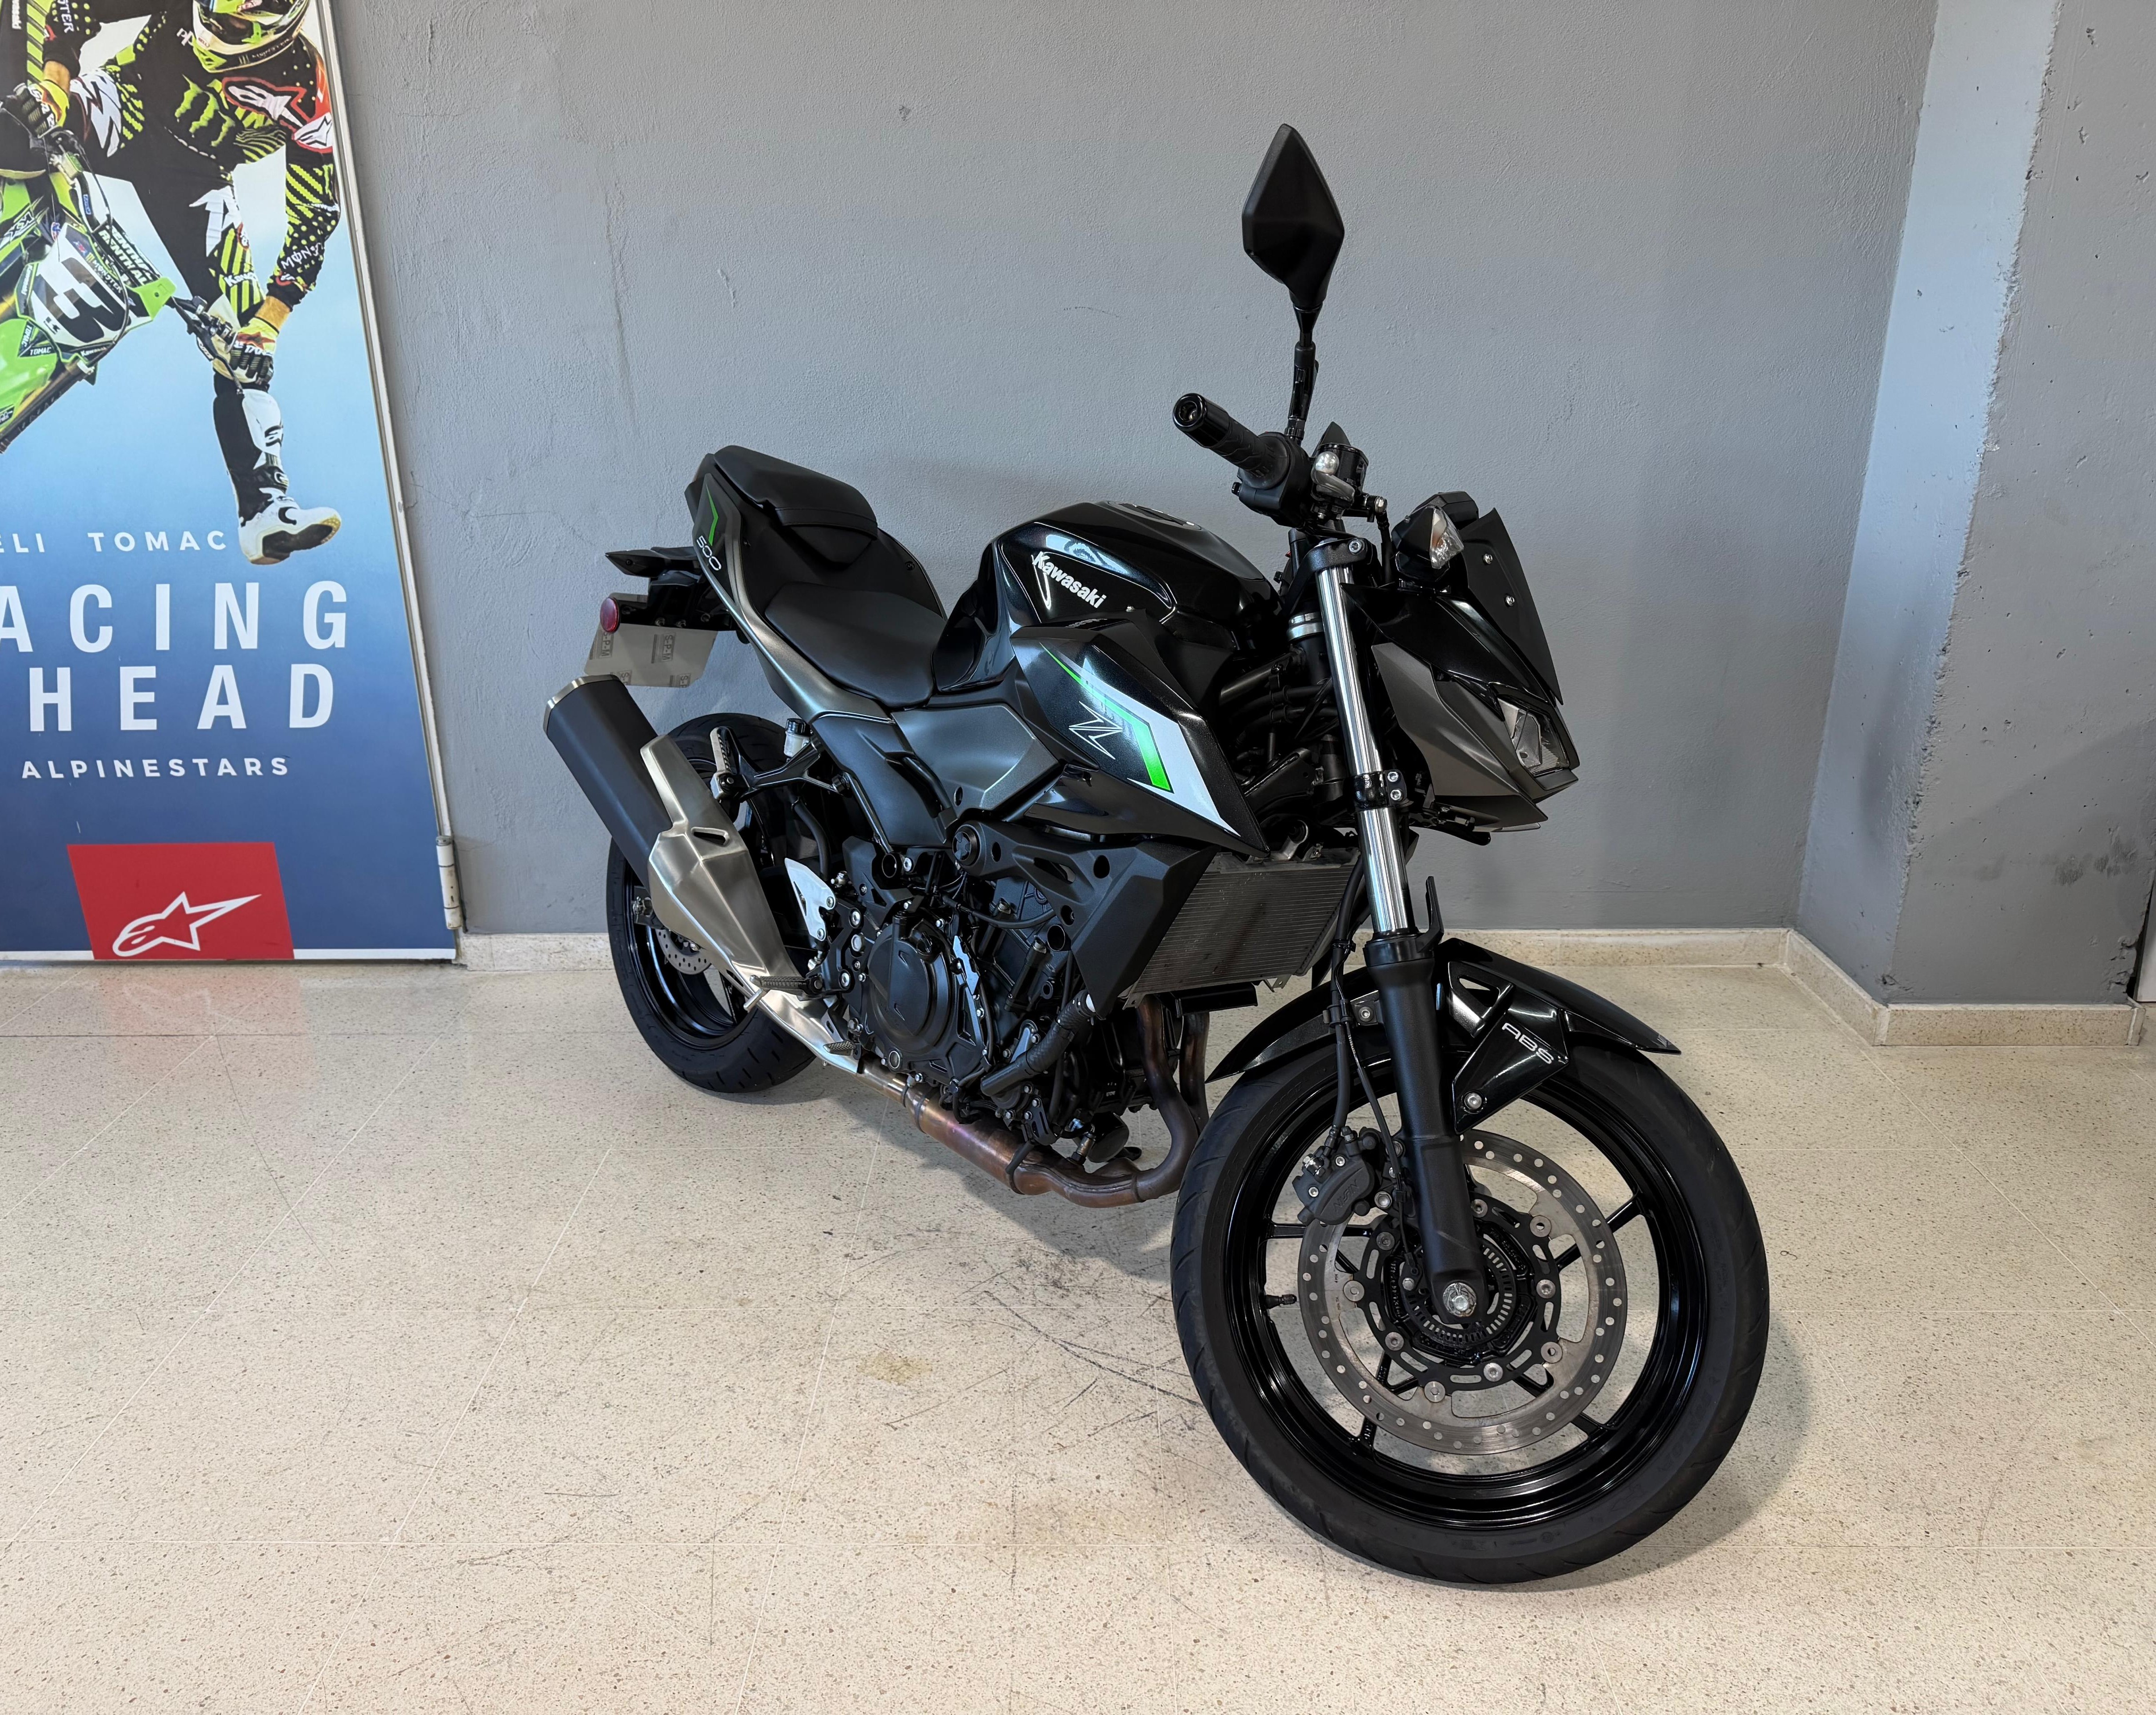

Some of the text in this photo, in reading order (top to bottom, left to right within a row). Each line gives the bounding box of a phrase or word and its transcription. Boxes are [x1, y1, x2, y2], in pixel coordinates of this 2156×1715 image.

[29, 347, 52, 356] TOMAC
[0, 530, 226, 553] LI TOMAC
[696, 535, 722, 571] 500
[1032, 551, 1107, 608] Kawasaki
[663, 634, 673, 660] S-P-M
[29, 664, 334, 732] HEAD
[22, 757, 288, 779] ALPINESTARS
[1501, 1022, 1554, 1064] ABS
